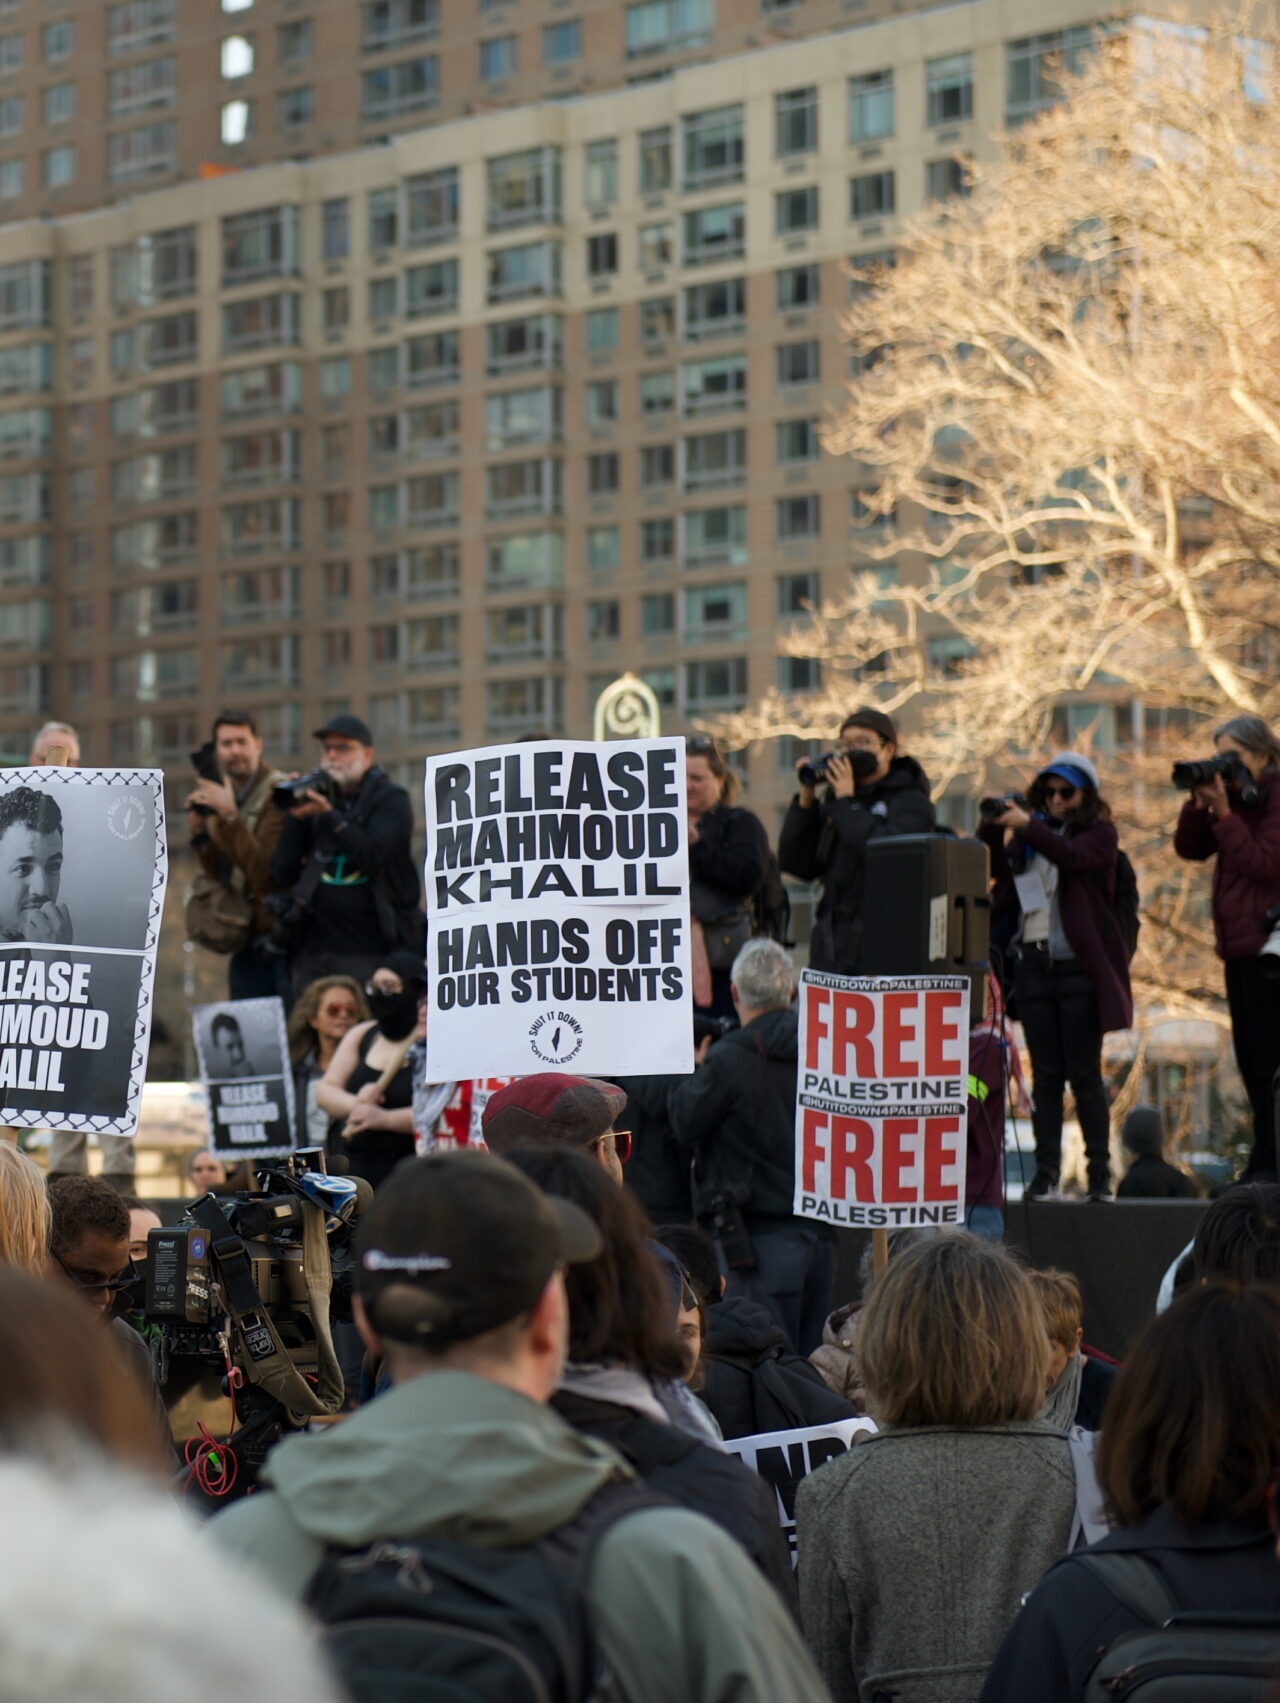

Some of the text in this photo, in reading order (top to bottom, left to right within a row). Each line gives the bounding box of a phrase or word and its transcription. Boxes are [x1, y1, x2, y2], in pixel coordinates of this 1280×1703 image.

[435, 749, 679, 824] RELEASE
[434, 813, 679, 871] MAHMOUD
[435, 863, 682, 910] KHALIL
[437, 917, 683, 975] HANDS OFF
[437, 966, 683, 1011] OUR STUDENTS
[529, 1011, 583, 1036] SHUT IT DOWN!
[805, 985, 962, 1078] FREE
[530, 1037, 583, 1064] FOR PALESTINE
[804, 1073, 961, 1101] PALESTINE
[802, 1108, 959, 1204] FREE
[801, 1196, 958, 1225] PALESTINE
